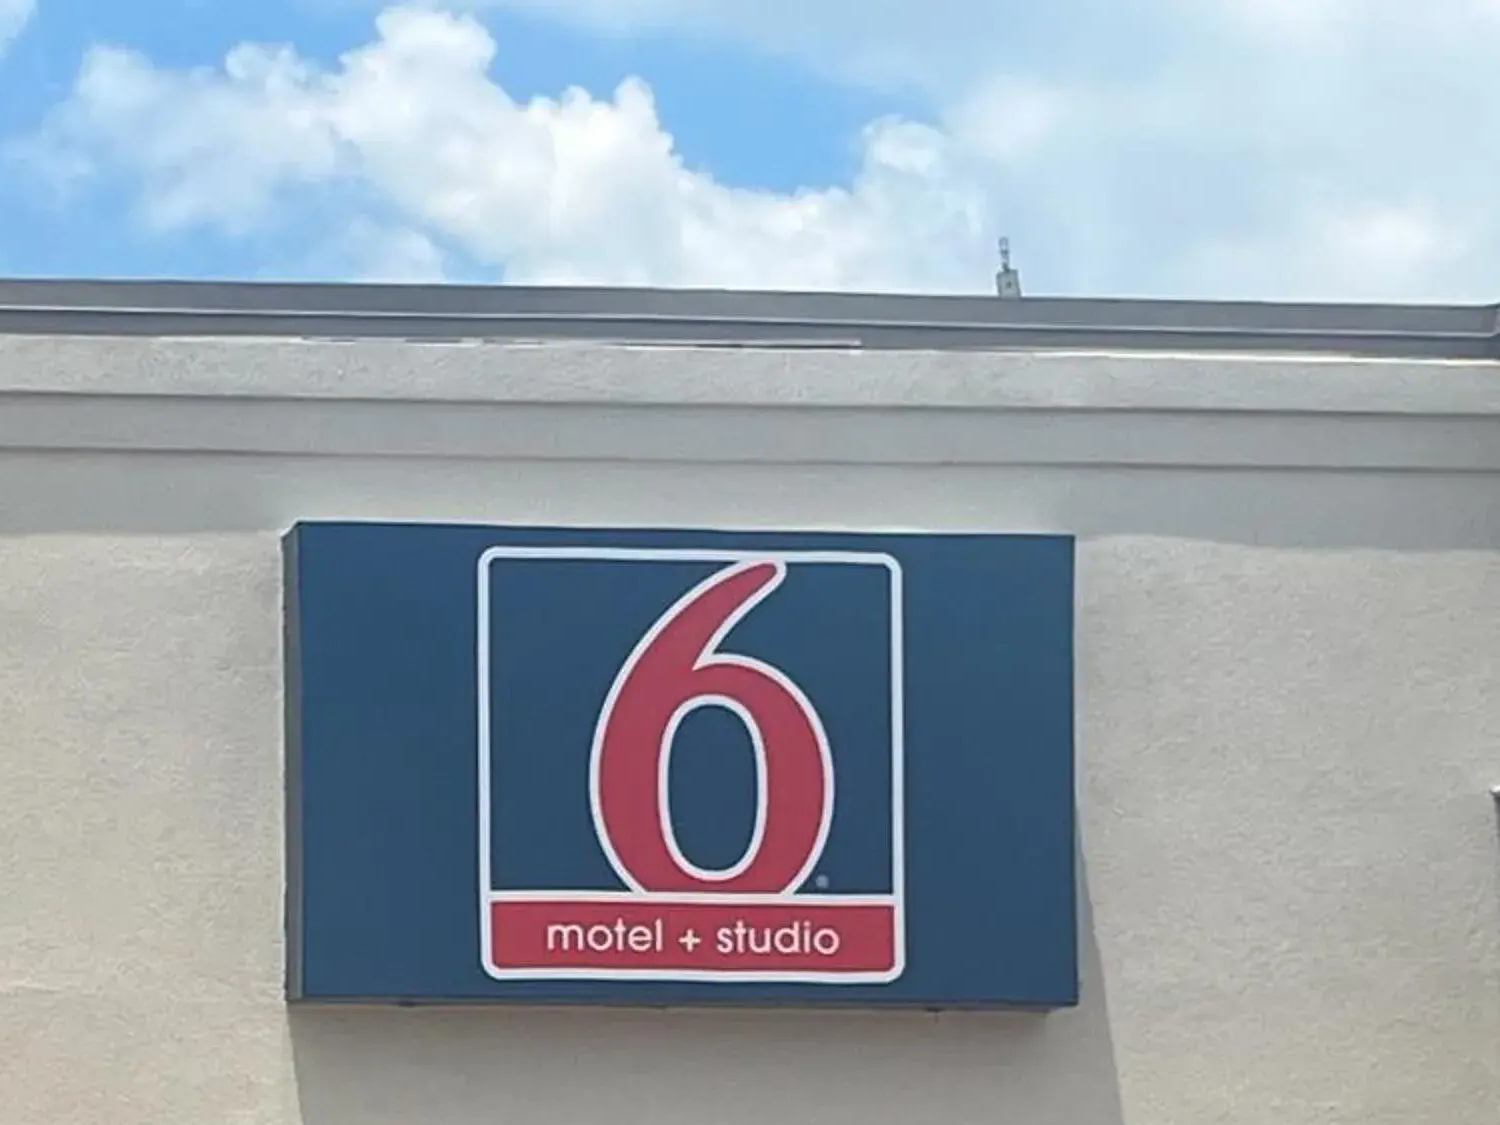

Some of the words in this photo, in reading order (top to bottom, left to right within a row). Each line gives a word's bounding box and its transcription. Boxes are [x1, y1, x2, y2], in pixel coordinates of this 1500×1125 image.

[590, 558, 834, 895] 6
[547, 918, 663, 951] motel
[716, 920, 841, 955] studio
